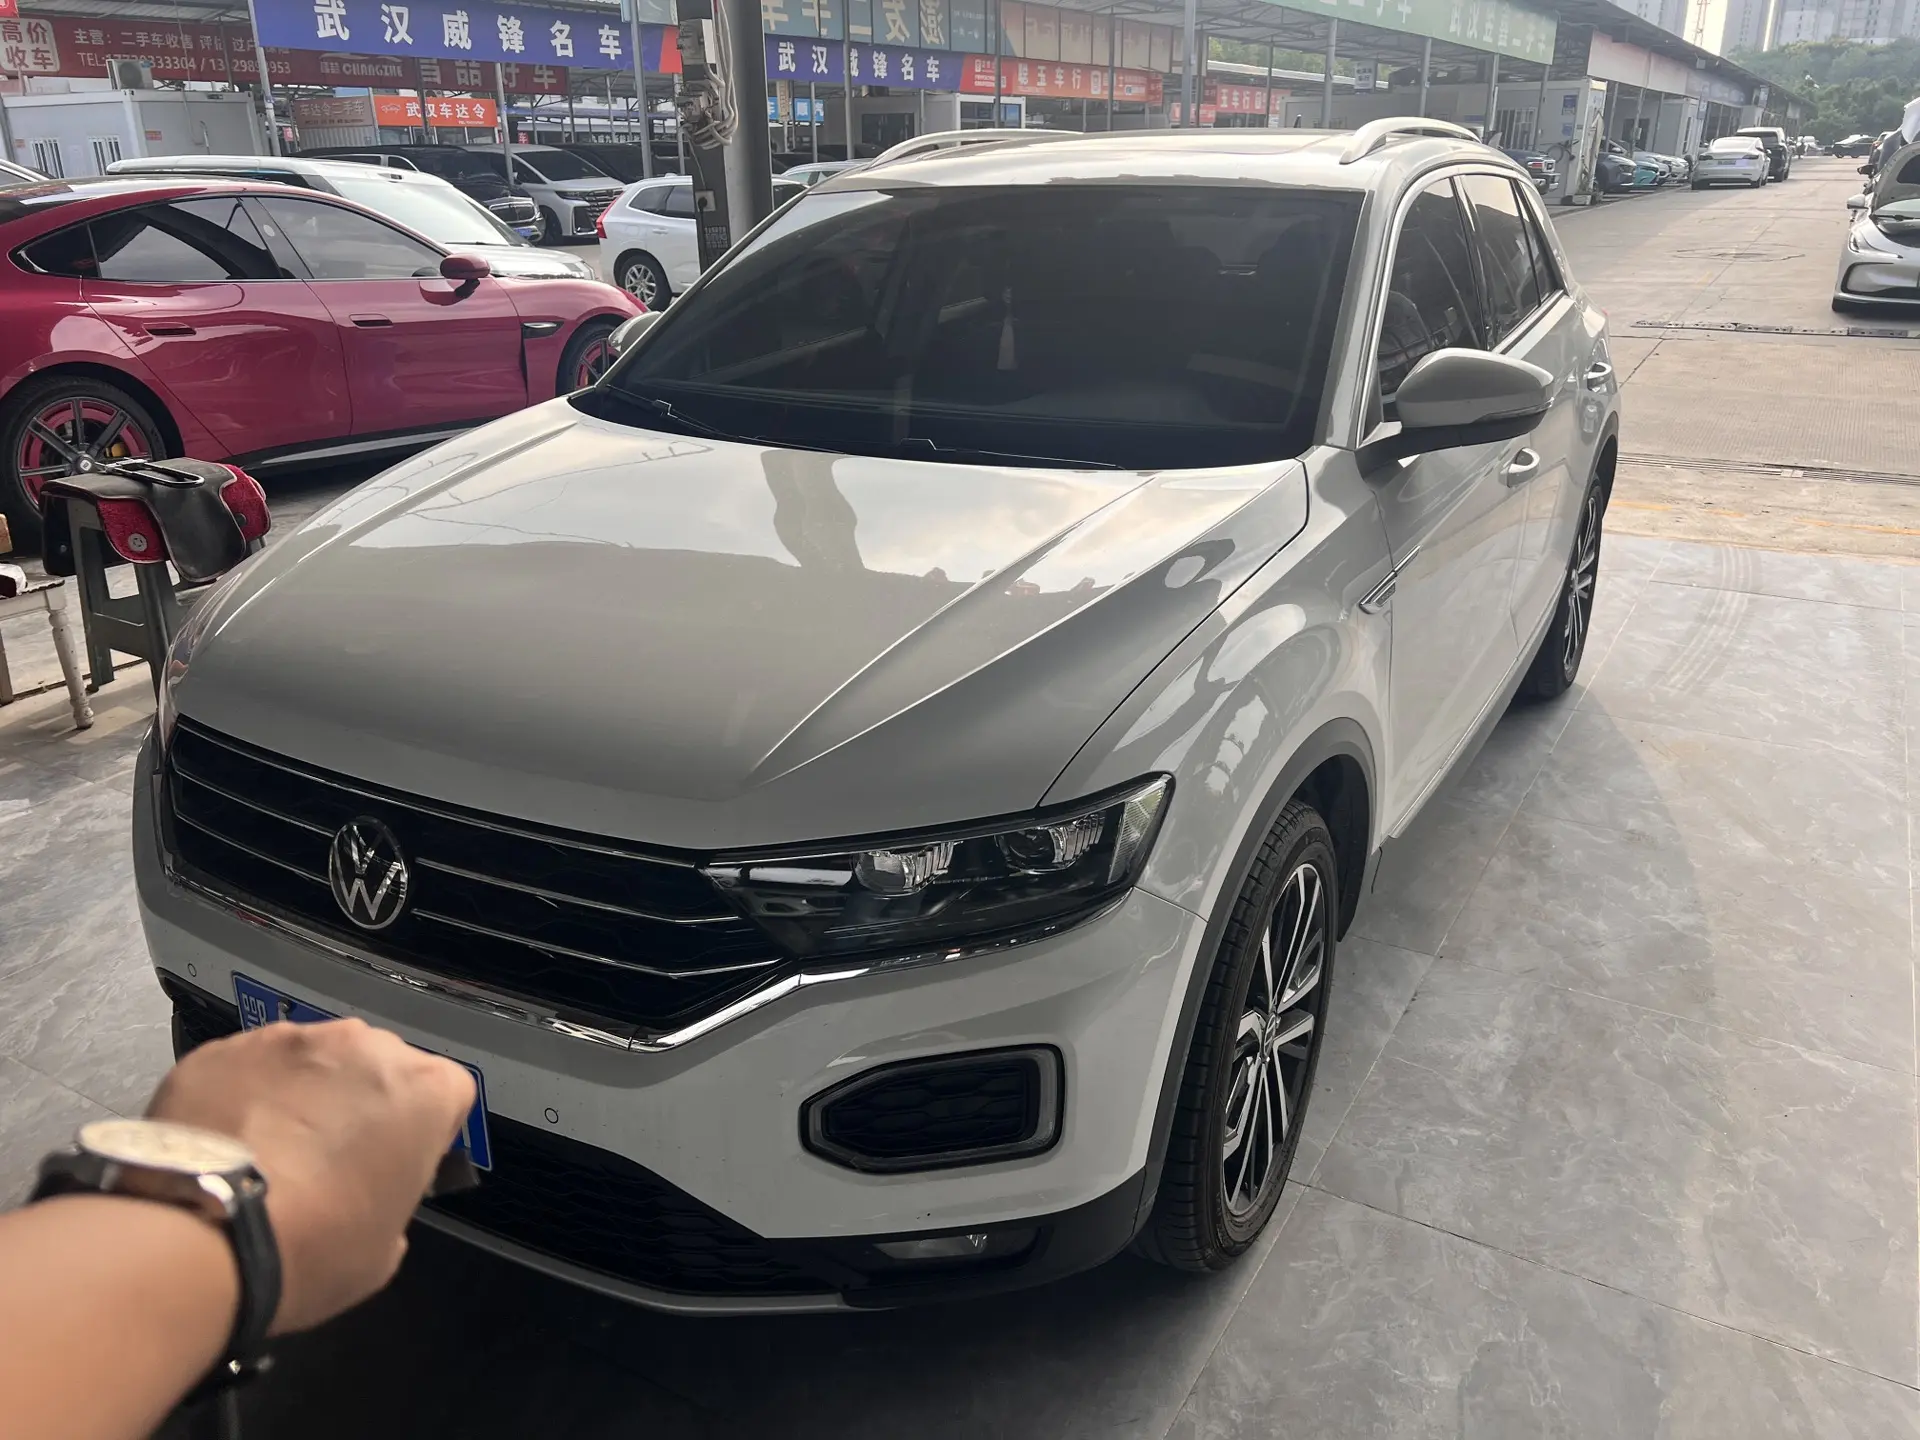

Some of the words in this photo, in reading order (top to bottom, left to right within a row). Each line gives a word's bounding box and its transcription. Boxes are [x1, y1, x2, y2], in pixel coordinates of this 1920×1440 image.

[2, 20, 47, 44] 高价
[313, 0, 622, 61] 武汉威锋名车
[6, 45, 53, 69] 收车
[406, 101, 486, 120] 武汉车达令
